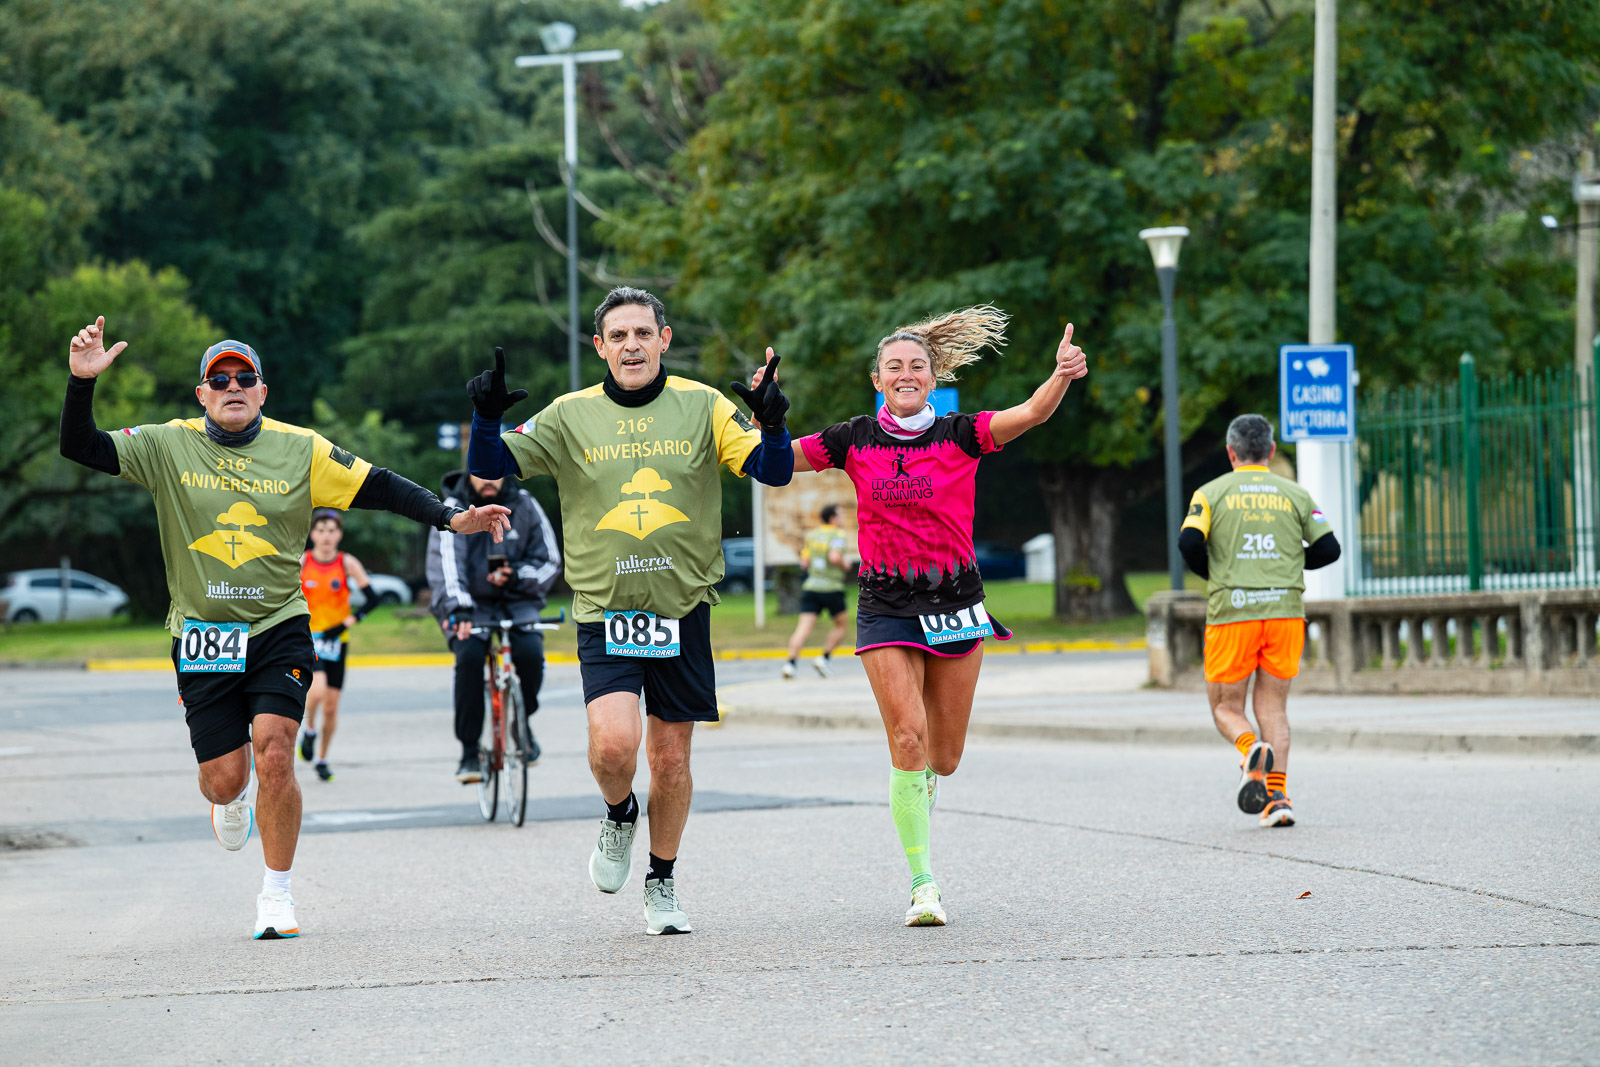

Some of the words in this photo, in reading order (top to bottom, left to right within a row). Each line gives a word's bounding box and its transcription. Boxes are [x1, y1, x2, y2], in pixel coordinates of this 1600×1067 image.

[1292, 385, 1342, 405] CASINO
[616, 416, 654, 435] 216°
[1288, 410, 1347, 429] VICTORIA
[584, 440, 692, 465] ANIVERSARIO
[216, 457, 252, 472] 216°
[180, 471, 290, 495] ANIVERSARIO
[872, 477, 932, 491] WOMAN
[872, 488, 934, 502] RUNNING
[1225, 493, 1293, 513] VICTORIA
[1242, 533, 1276, 551] 216
[615, 554, 673, 575] julicroc
[206, 580, 265, 598] julicroc
[609, 612, 673, 648] 085
[931, 632, 966, 643] DIAMANTE
[966, 628, 989, 638] CORRE
[185, 626, 242, 662] 084
[610, 648, 649, 656] DIAMANTE
[650, 648, 677, 656] CORRE
[182, 663, 217, 671] DIAMANTE
[218, 663, 242, 671] CORRE
